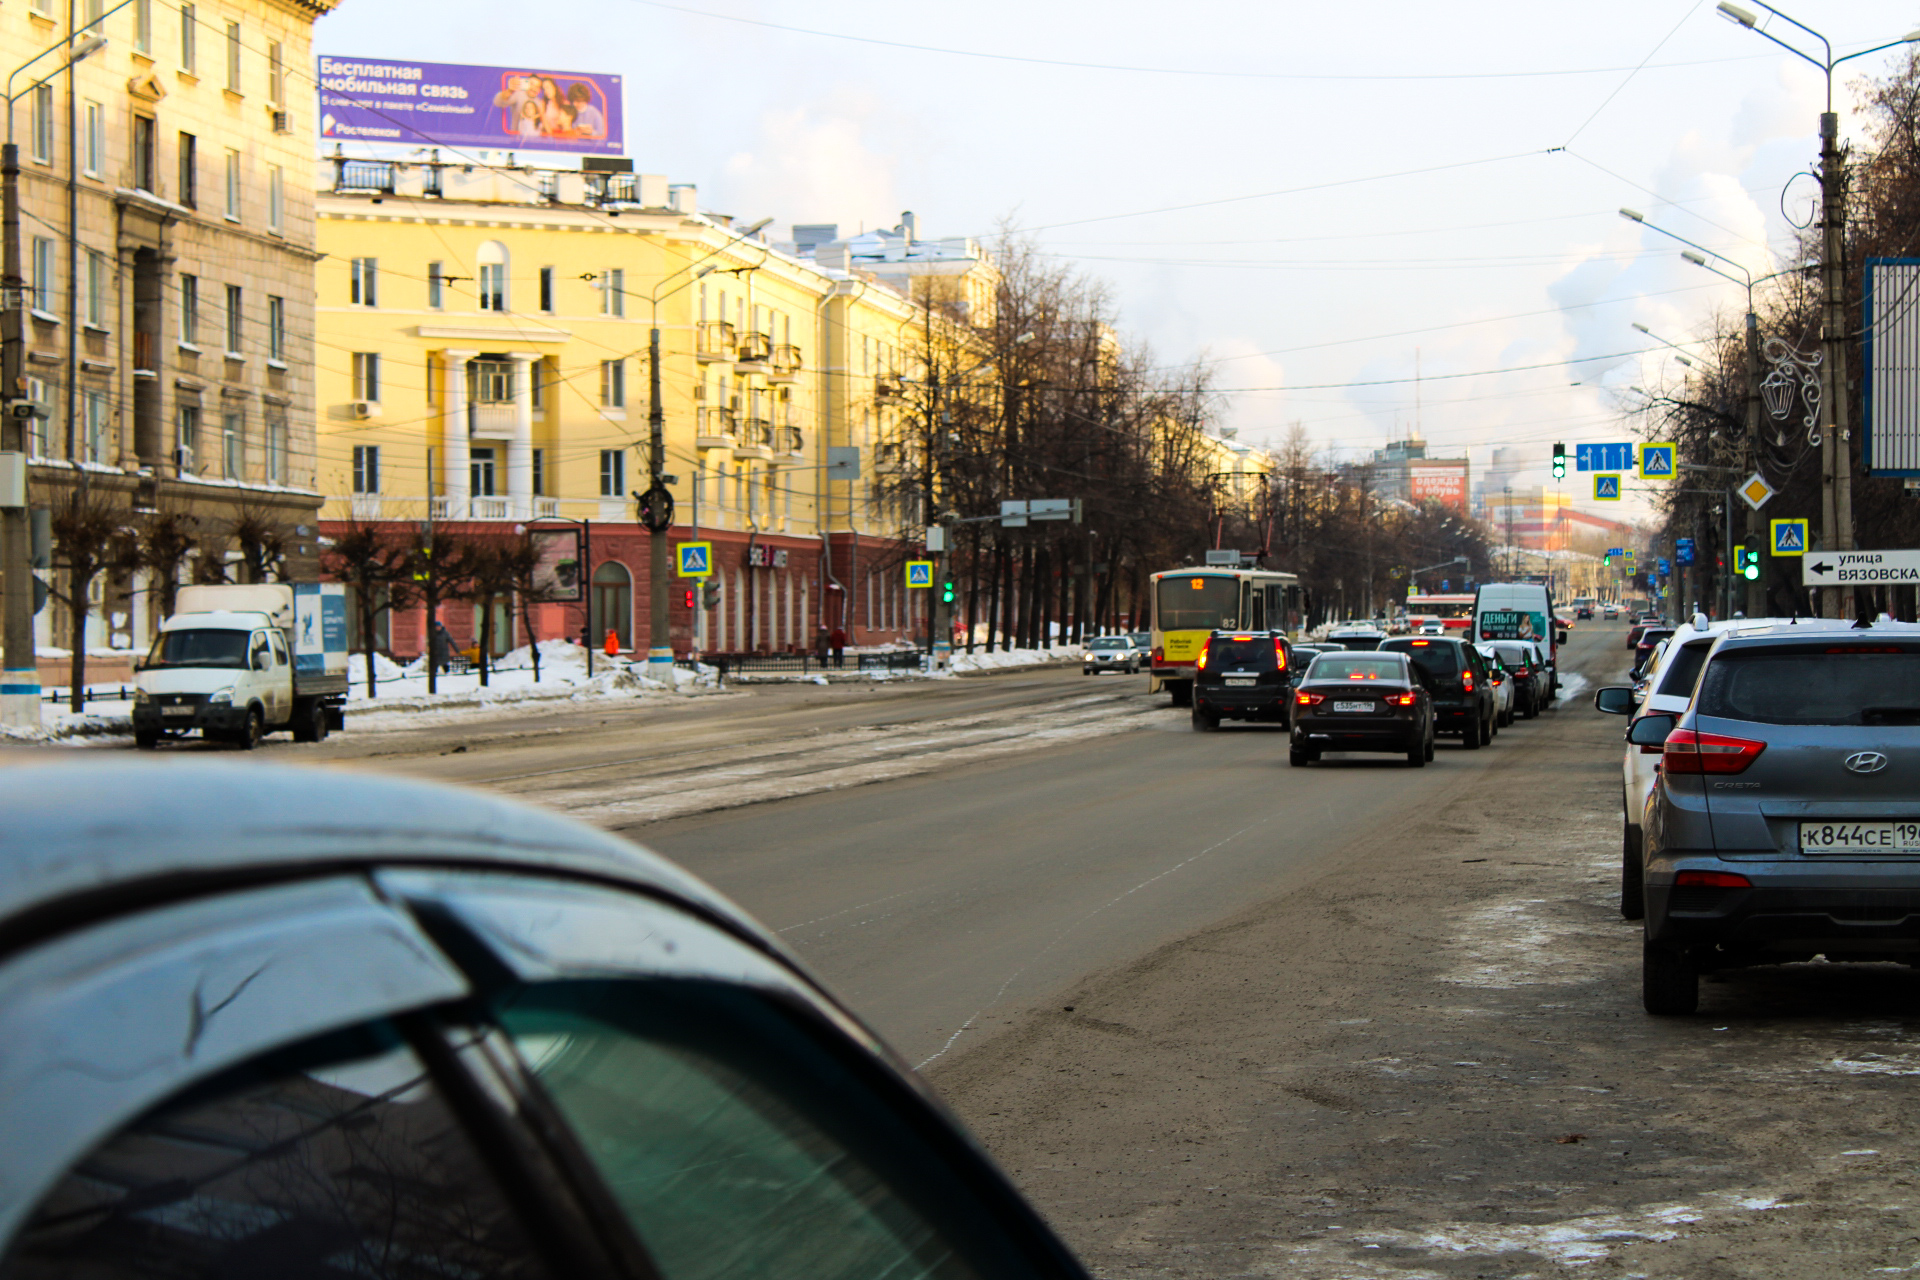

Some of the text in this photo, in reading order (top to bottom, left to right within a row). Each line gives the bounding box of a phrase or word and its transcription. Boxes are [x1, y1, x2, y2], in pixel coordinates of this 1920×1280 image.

[320, 57, 422, 80] Бесплатная
[320, 75, 468, 99] мобильная связь
[375, 101, 381, 109] в
[383, 101, 414, 111] пакете
[336, 123, 401, 138] Ростелеком
[1415, 477, 1460, 487] одежда
[1415, 485, 1460, 497] и обувь
[1838, 554, 1883, 566] улица
[1838, 568, 1919, 581] ВЯЗОВСКА
[1191, 578, 1204, 589] 12
[1222, 618, 1236, 629] 82
[1482, 613, 1517, 625] ДЕНЬГИ
